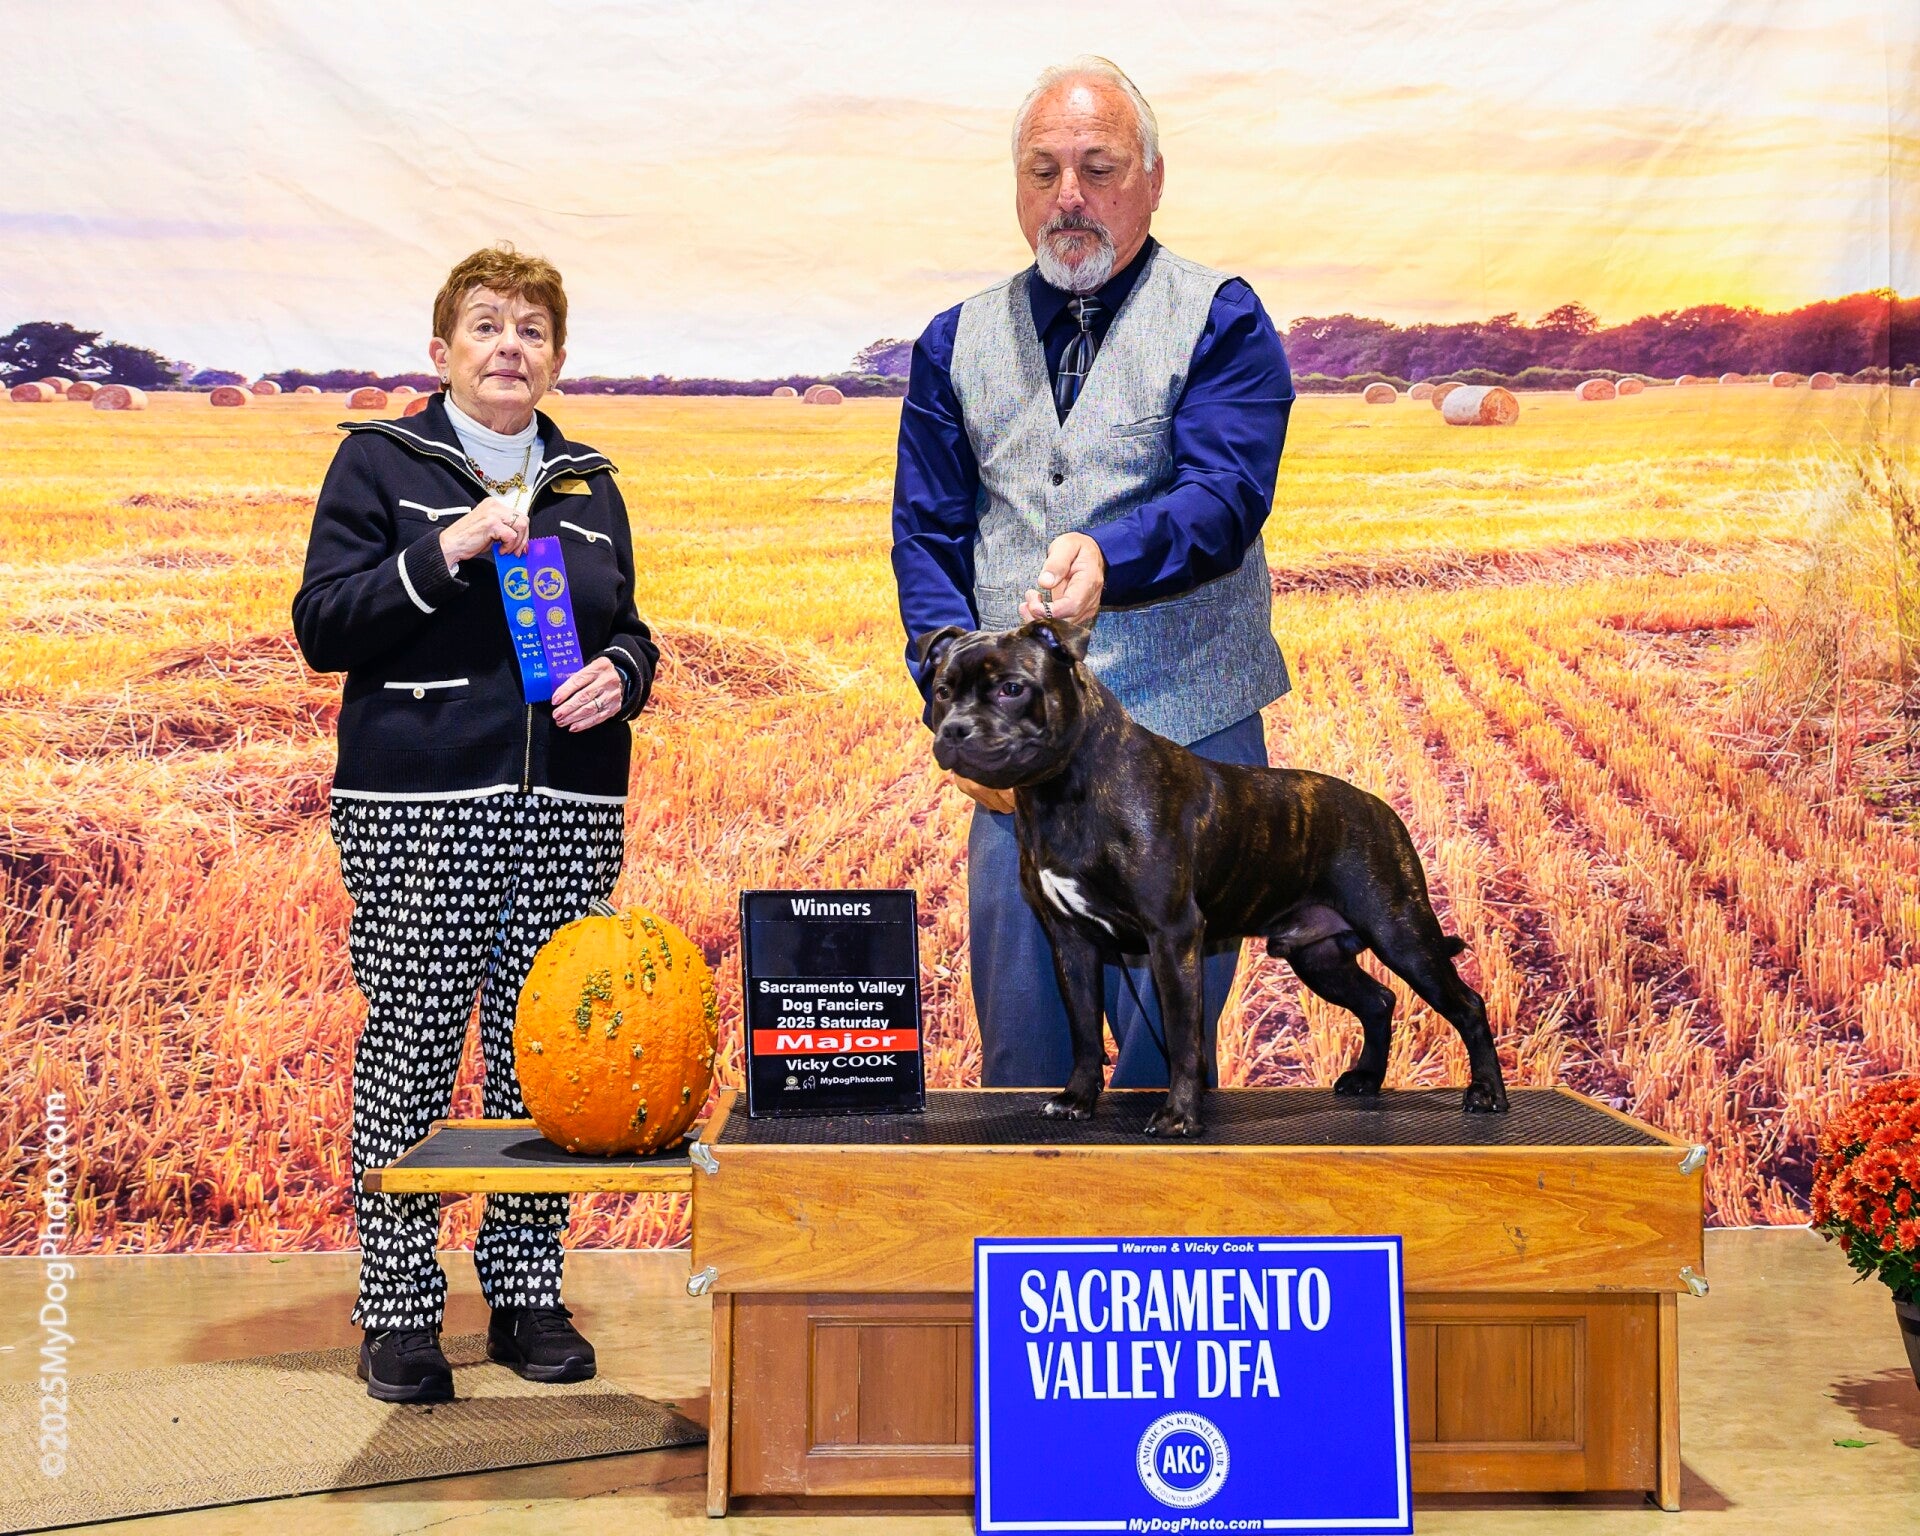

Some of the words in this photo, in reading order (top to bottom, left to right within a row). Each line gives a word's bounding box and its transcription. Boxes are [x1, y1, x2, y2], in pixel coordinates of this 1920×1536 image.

[791, 898, 871, 916] Winners
[760, 981, 854, 994] Sacramento
[858, 981, 905, 996] Valley
[783, 999, 813, 1012] Dog
[818, 999, 884, 1011] Fanciers
[777, 1017, 816, 1029] 2025
[820, 1017, 889, 1030] Saturday
[776, 1033, 897, 1052] Major
[786, 1059, 829, 1072] Vicky
[832, 1055, 897, 1068] COOK
[820, 1075, 893, 1085] MyDogPhoto.com
[1122, 1243, 1167, 1253] Warren
[1171, 1243, 1180, 1253] &
[1184, 1242, 1219, 1256] Vicky
[1222, 1242, 1255, 1253] Cook
[1019, 1267, 1331, 1334] SACRAMENTO
[1026, 1340, 1181, 1400] VALLEY
[1197, 1339, 1281, 1399] DFA
[1142, 1418, 1175, 1467] AMERICAN
[1176, 1417, 1214, 1439] KENNEL
[1212, 1438, 1224, 1467] CLUB
[1162, 1444, 1206, 1475] AKC
[1156, 1486, 1193, 1503] FOUNDED
[1196, 1486, 1212, 1500] 1884
[1128, 1518, 1262, 1533] MyDogPhoto.com
